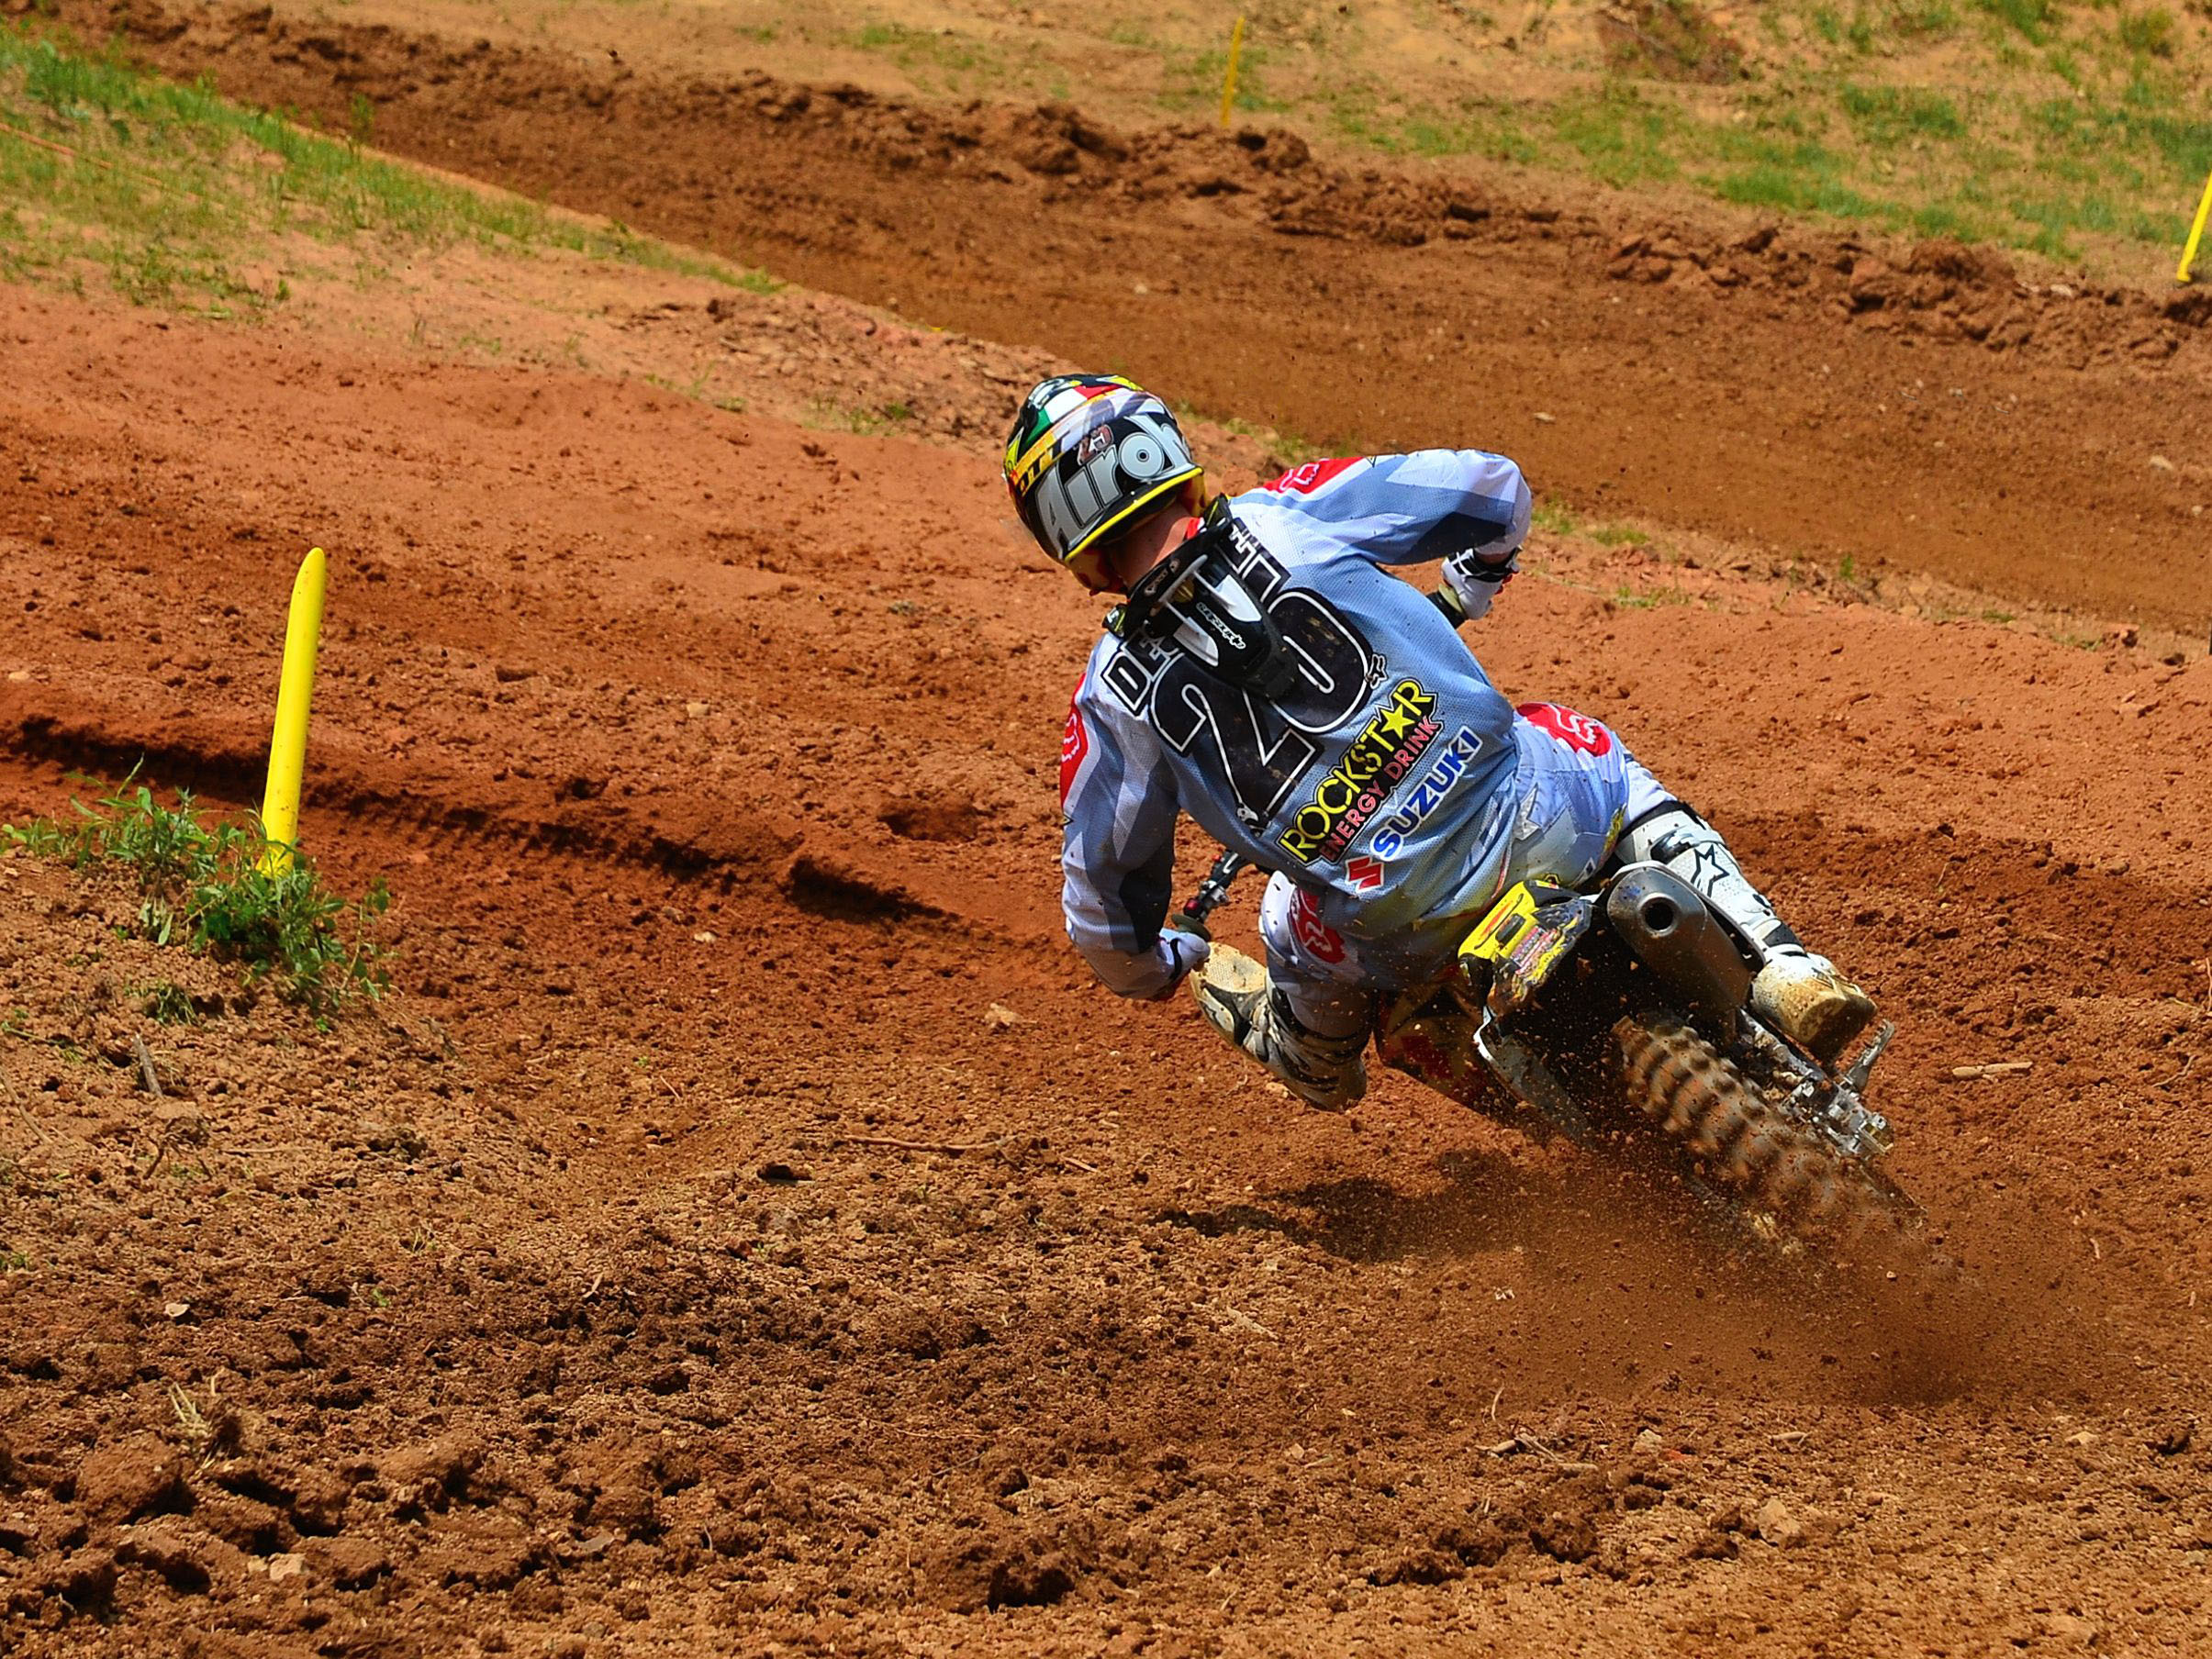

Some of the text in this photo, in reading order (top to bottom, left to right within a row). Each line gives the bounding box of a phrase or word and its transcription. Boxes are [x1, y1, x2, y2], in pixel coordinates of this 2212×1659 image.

[1146, 587, 1370, 830] 20
[1319, 715, 1440, 862] ENERGY DRINK
[1372, 727, 1481, 859] SUZUKI
